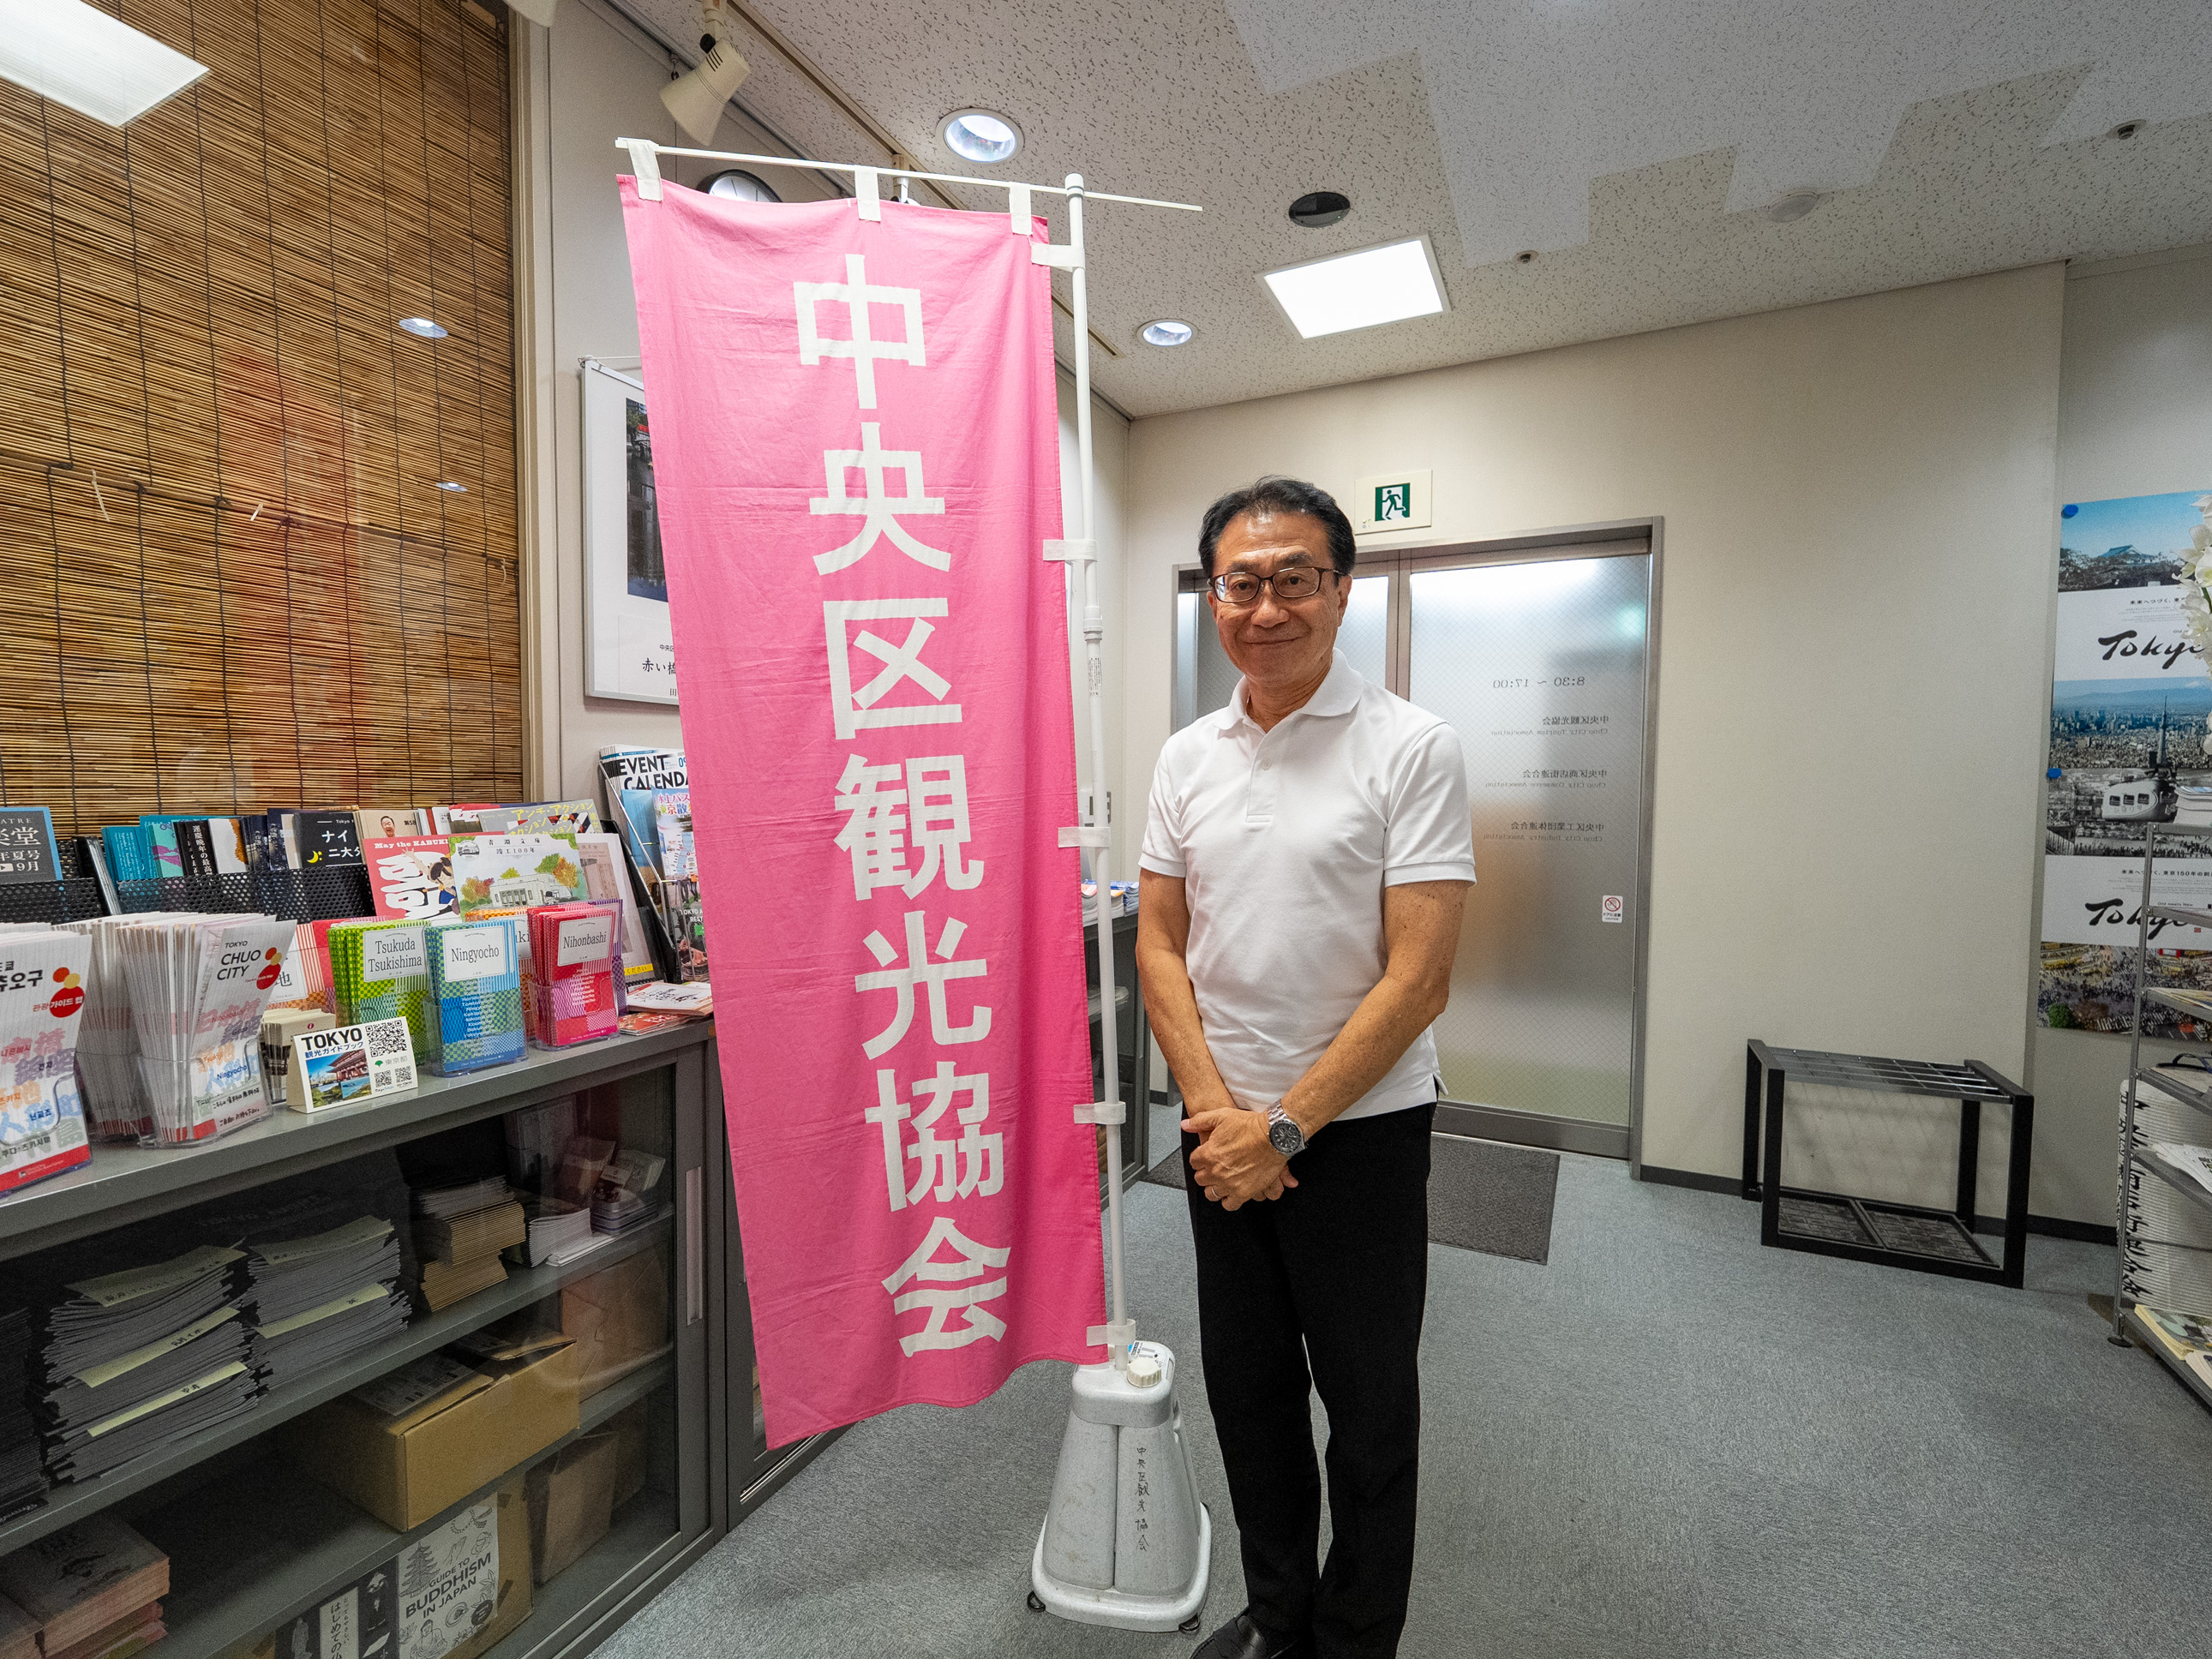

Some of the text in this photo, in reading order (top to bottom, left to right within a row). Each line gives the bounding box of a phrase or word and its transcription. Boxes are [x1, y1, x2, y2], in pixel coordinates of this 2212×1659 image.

[2130, 597, 2185, 606] 未来へつづく、東
[619, 754, 671, 776] EVENT
[658, 794, 691, 804] 水上バス
[792, 254, 1011, 1357] 中央区観光協会
[660, 804, 692, 815] 東京散
[17, 861, 39, 871] 9月
[375, 937, 416, 954] Tsukuda
[563, 931, 607, 949] Nihonbashi
[221, 949, 261, 965] CHUO
[452, 944, 500, 963] Ningyocho
[369, 955, 422, 972] Tsukishima
[217, 965, 249, 980] CITY
[302, 1027, 363, 1051] TOKYO
[305, 1042, 363, 1058] 観光ガイドブック
[217, 1065, 247, 1080] Ningyocho
[1135, 1446, 1150, 1552] 中央区観光協会
[429, 1556, 471, 1589] GUIDE TO
[405, 1552, 492, 1618] BUDDHISM
[423, 1576, 477, 1620] IN JAPAN
